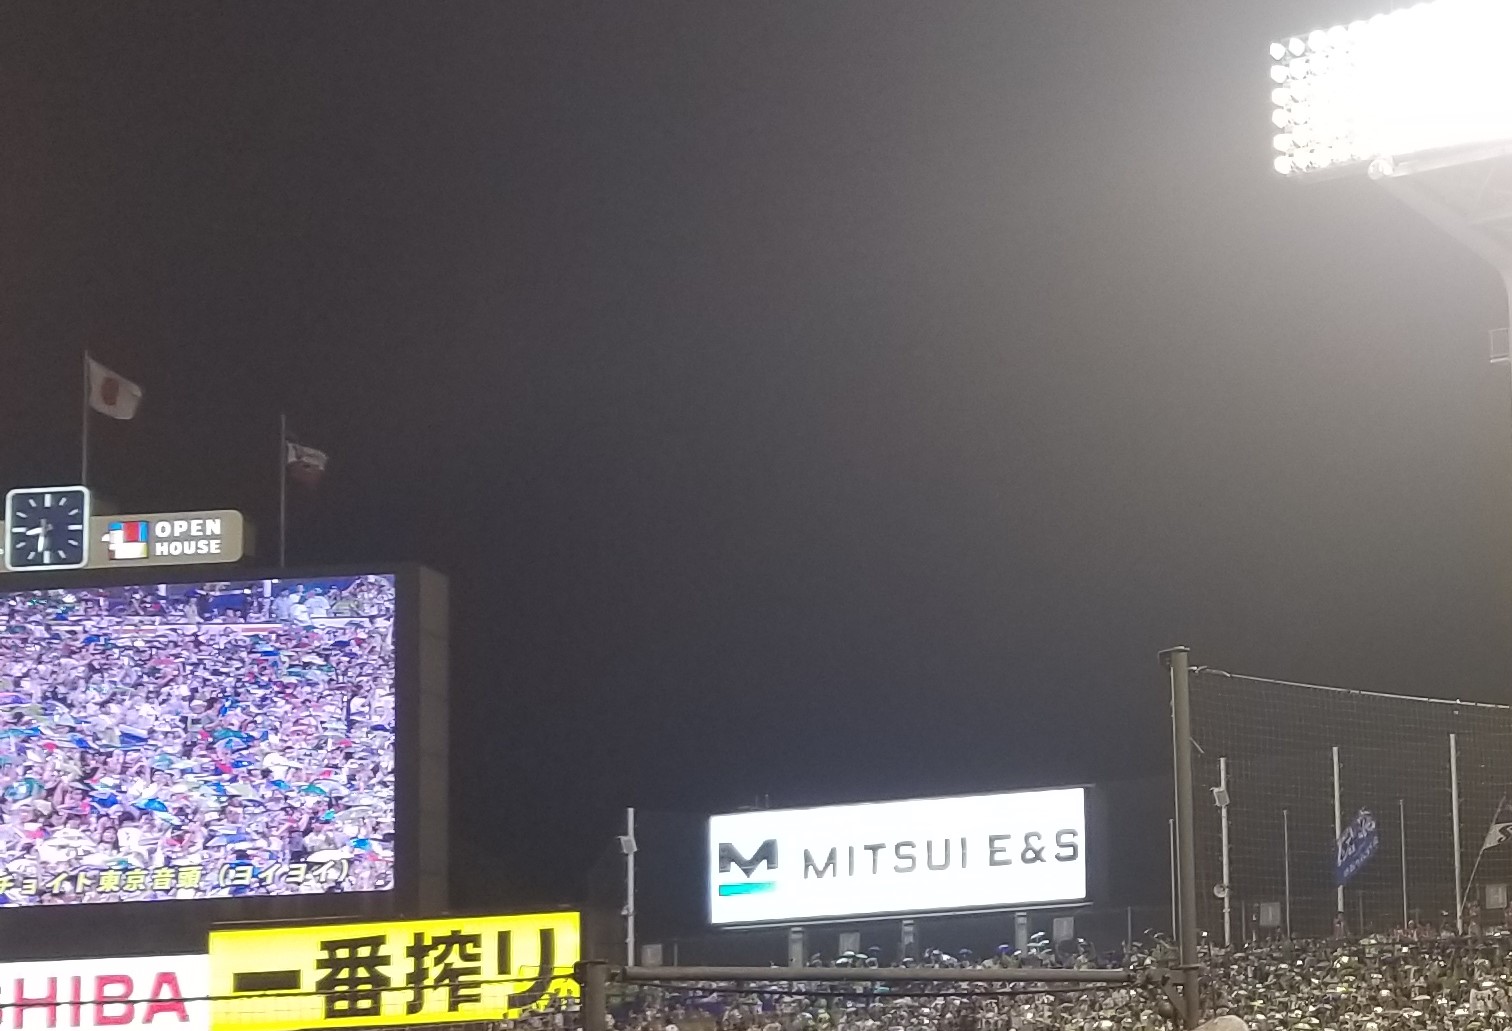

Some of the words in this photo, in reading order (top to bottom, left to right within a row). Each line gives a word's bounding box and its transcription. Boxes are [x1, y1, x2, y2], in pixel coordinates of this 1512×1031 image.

[155, 518, 221, 537] OPEN
[155, 540, 221, 556] HOUSE
[804, 840, 967, 879] MITSUI
[989, 829, 1079, 867] E&S
[233, 928, 555, 1020] 一番搾り
[0, 972, 190, 1030] HIBA
